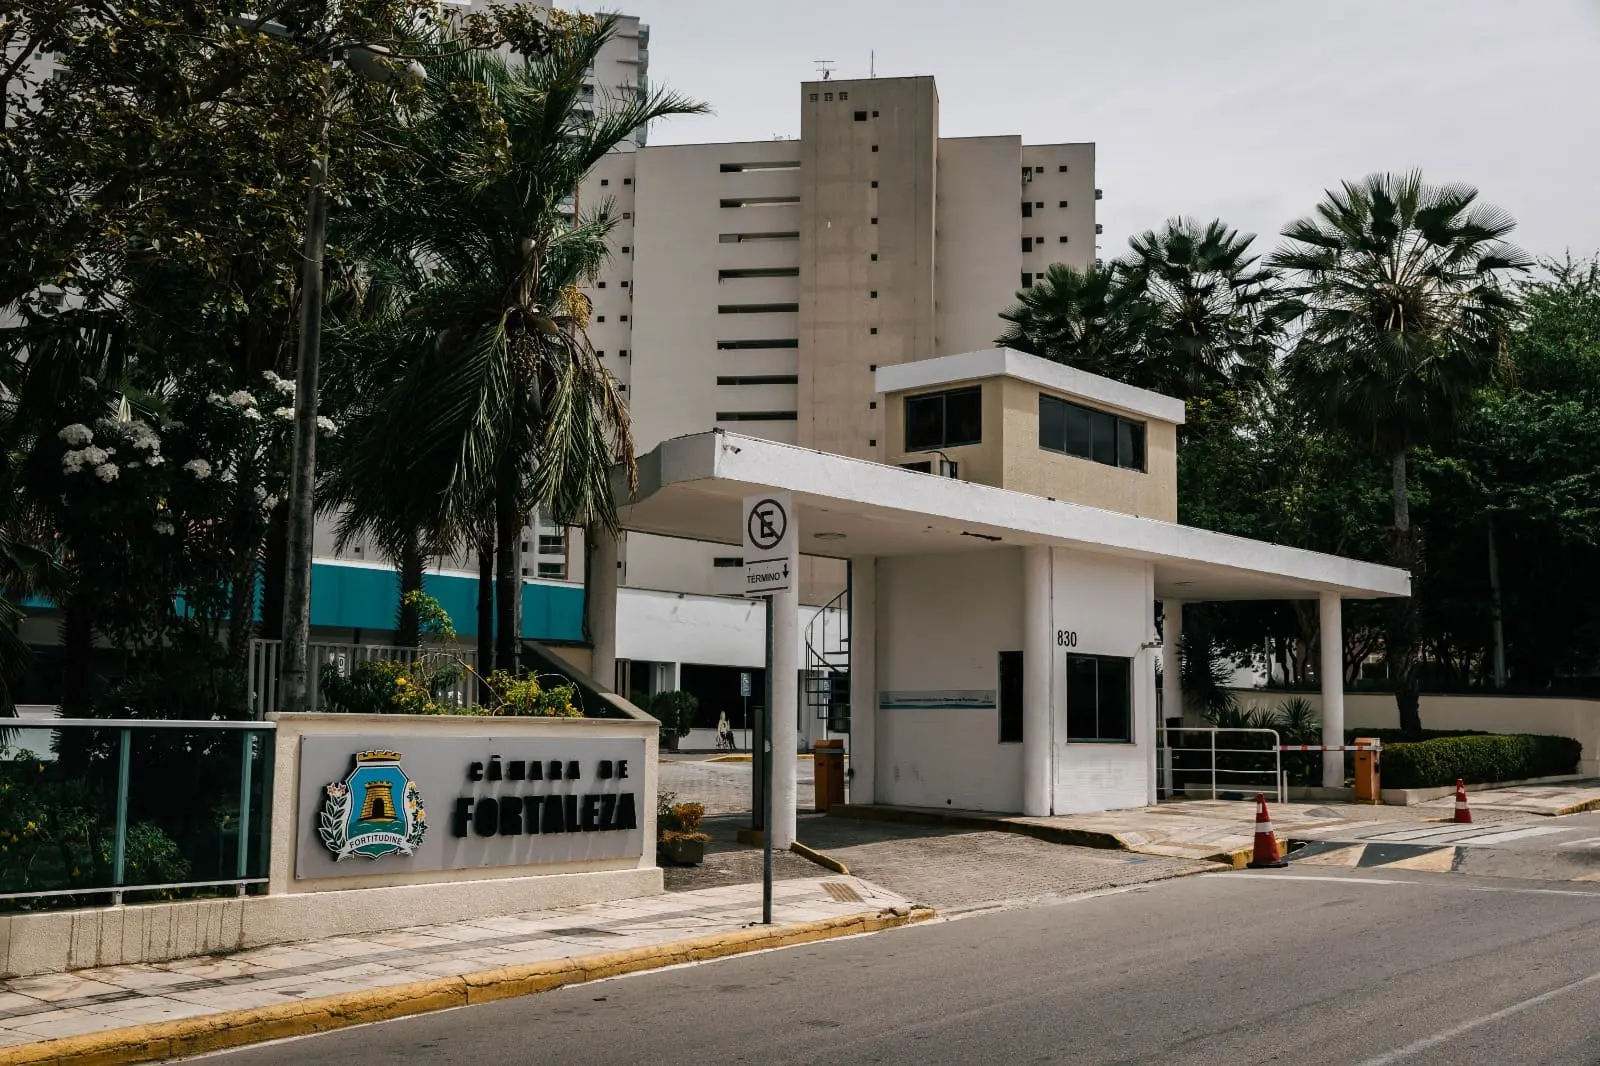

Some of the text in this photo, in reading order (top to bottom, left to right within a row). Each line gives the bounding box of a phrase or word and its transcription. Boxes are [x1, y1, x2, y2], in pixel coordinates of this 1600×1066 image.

[760, 510, 774, 538] E
[1057, 630, 1076, 647] 830
[599, 760, 628, 779] DE
[455, 793, 637, 837] FORTALEZA
[349, 835, 402, 848] FORTITUDINE
